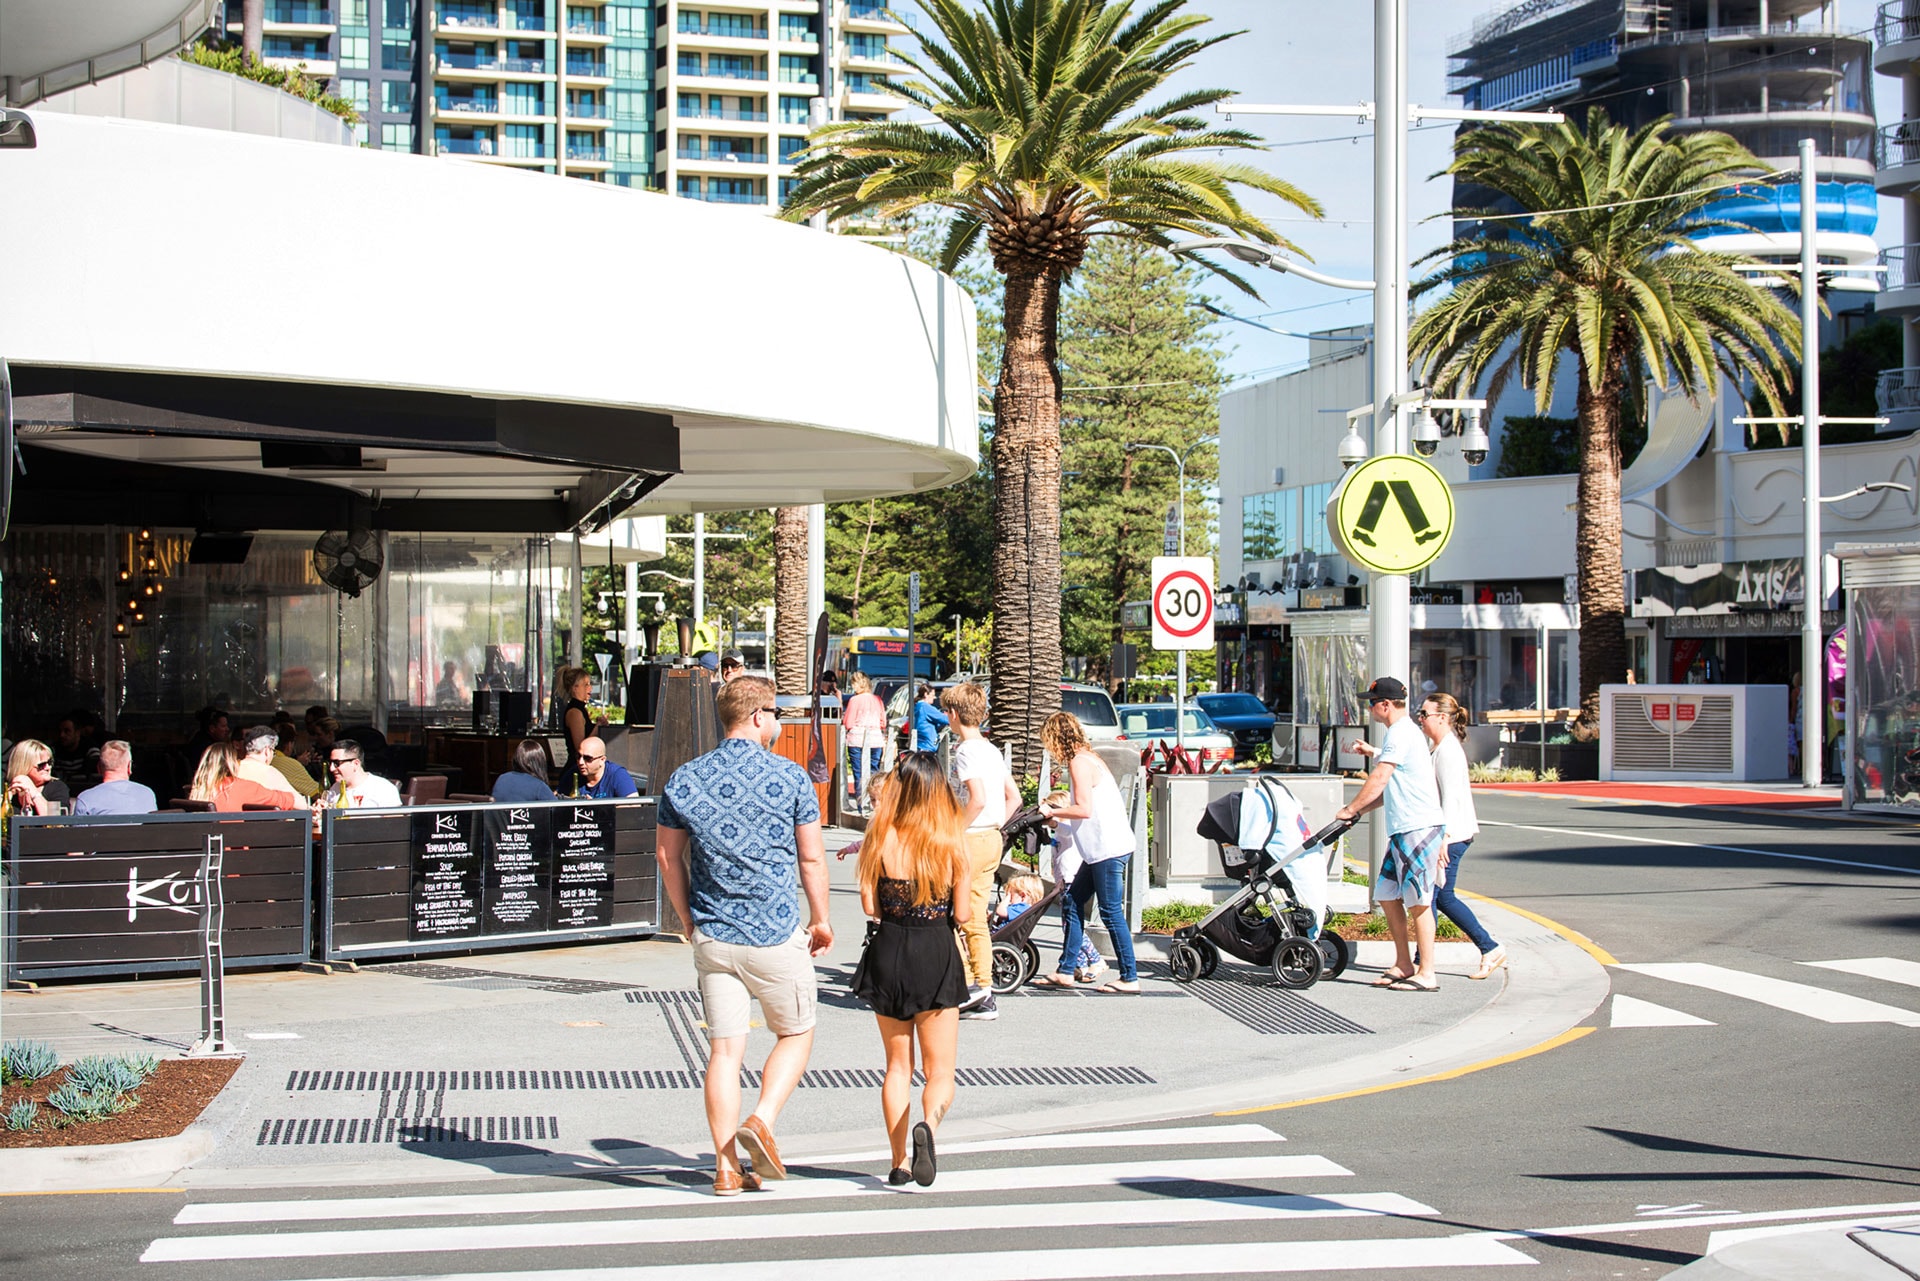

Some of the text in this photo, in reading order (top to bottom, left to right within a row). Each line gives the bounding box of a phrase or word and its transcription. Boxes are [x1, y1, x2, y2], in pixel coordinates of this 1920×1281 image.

[1166, 588, 1202, 618] 30
[1496, 586, 1523, 604] nab
[1746, 613, 1765, 628] PASTA
[1772, 612, 1792, 627] TAPAS
[436, 813, 458, 833] Koi
[510, 808, 530, 824] Koi
[440, 862, 454, 871] SOUP
[443, 882, 452, 890] THE
[452, 881, 462, 890] DAY
[126, 866, 201, 923] Koi
